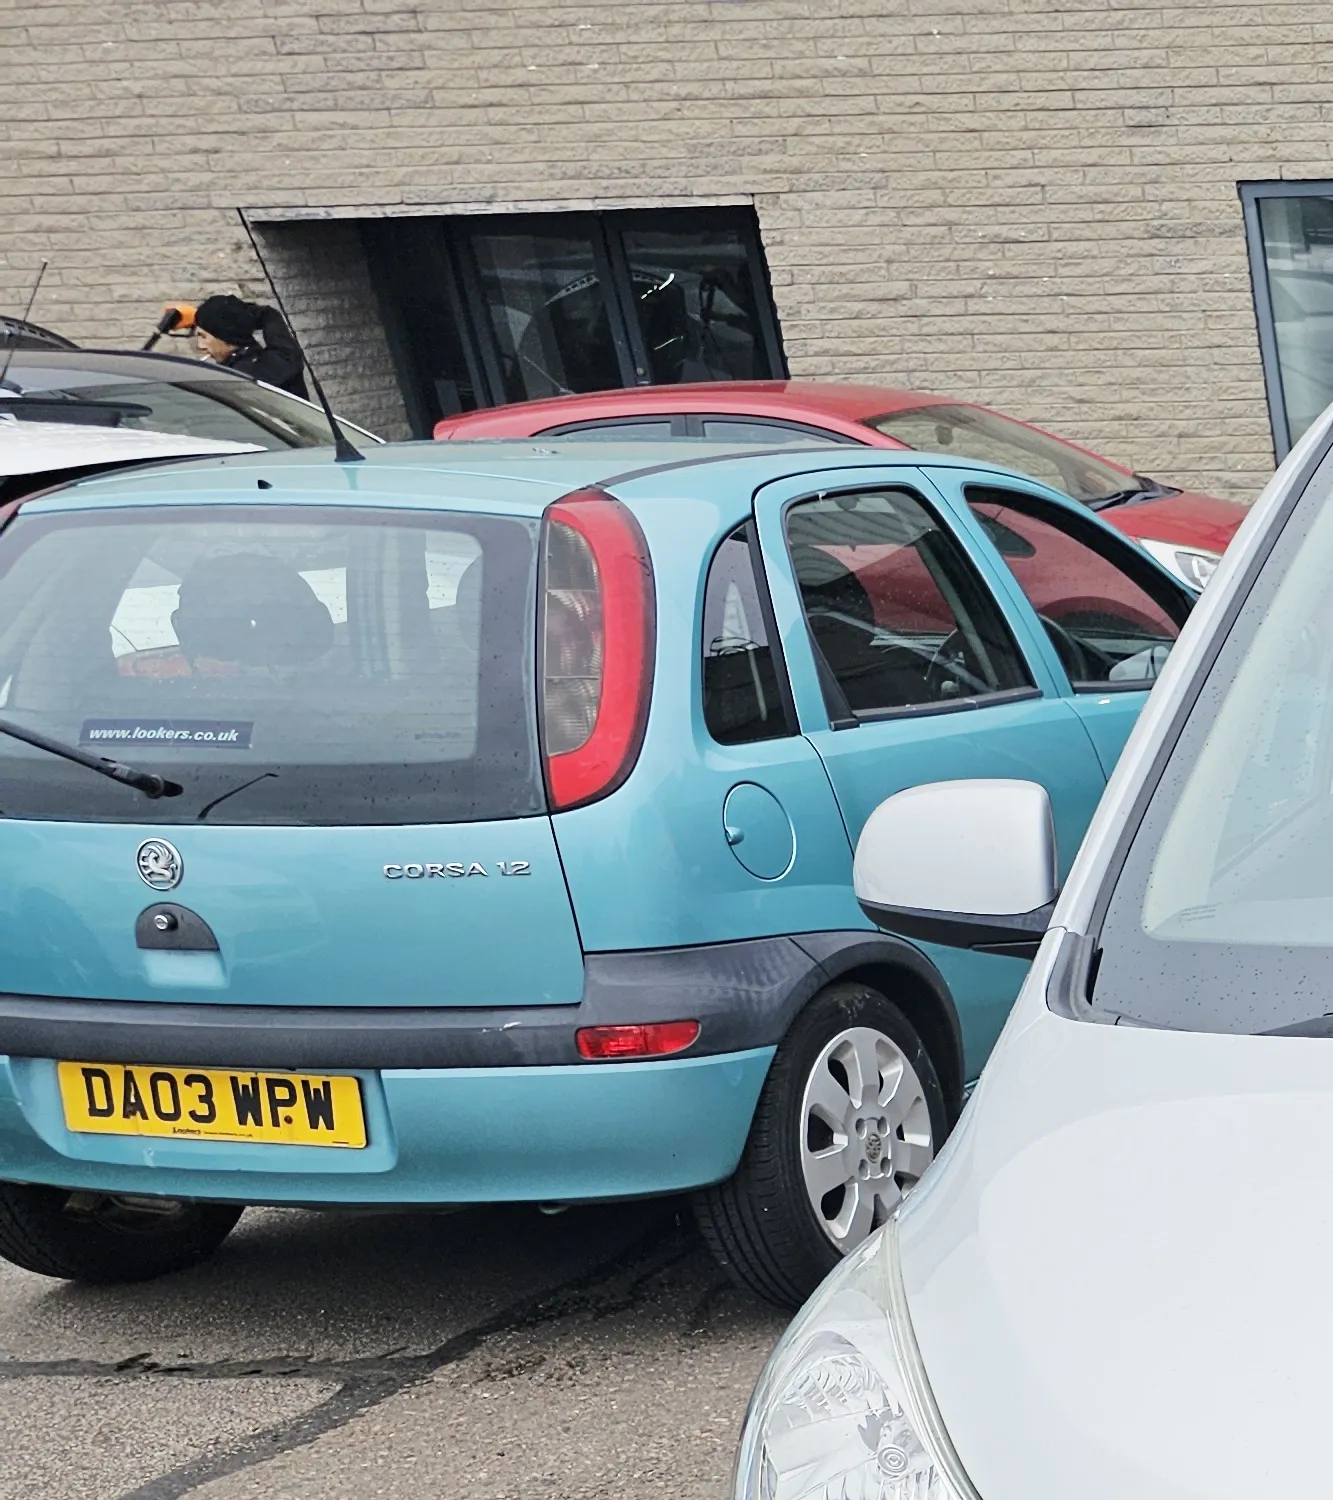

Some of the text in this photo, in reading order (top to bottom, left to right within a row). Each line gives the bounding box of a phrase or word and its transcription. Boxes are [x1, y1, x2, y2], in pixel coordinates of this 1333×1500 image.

[88, 726, 240, 742] www.lookers.co.uk
[382, 861, 490, 880] CORSA
[81, 1067, 336, 1132] DA03 WPW
